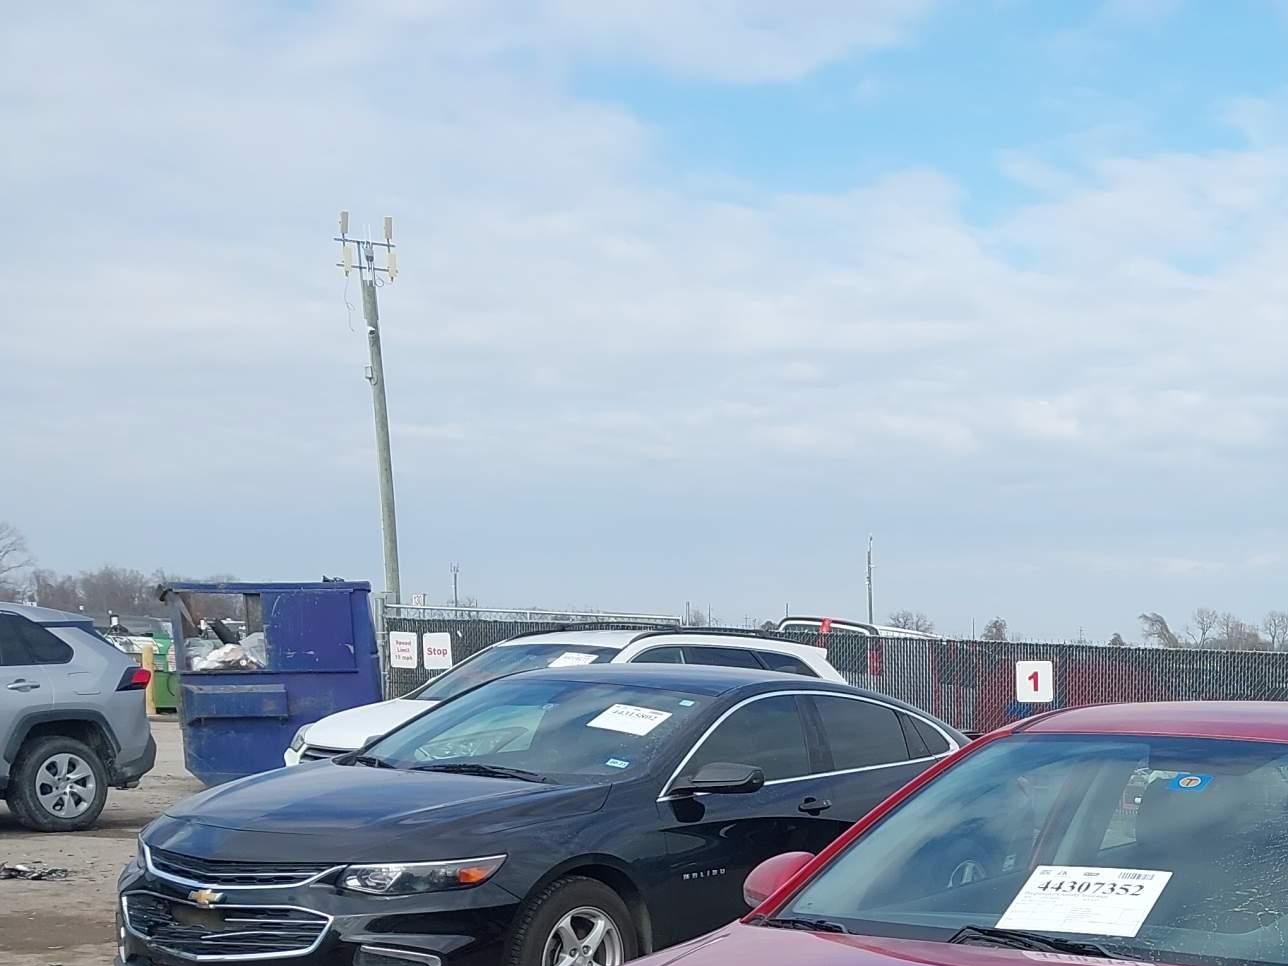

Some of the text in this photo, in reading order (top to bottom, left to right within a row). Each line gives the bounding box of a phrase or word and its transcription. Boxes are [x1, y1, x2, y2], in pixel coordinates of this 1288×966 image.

[427, 647, 448, 657] Stop
[1028, 671, 1039, 692] 1
[682, 868, 726, 880] MALIBU
[1037, 879, 1145, 896] 44307352
